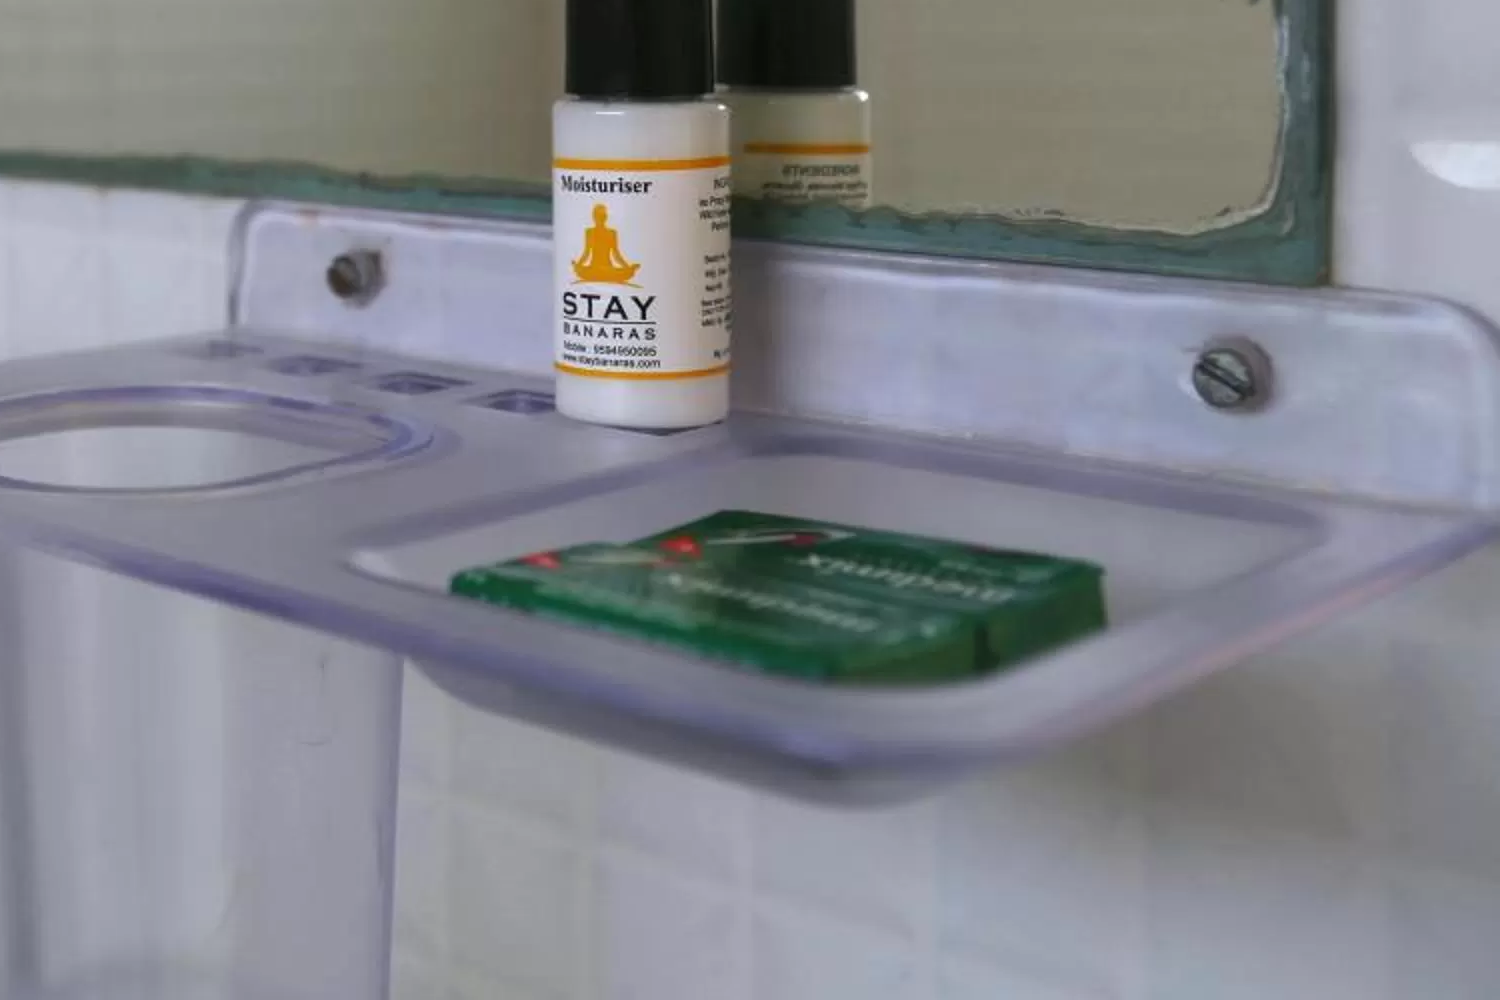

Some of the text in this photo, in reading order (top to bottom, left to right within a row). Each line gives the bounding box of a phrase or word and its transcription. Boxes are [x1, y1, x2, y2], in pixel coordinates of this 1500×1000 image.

[561, 175, 653, 194] Moisturiser
[563, 291, 657, 321] STAY
[563, 321, 657, 341] BANARAS
